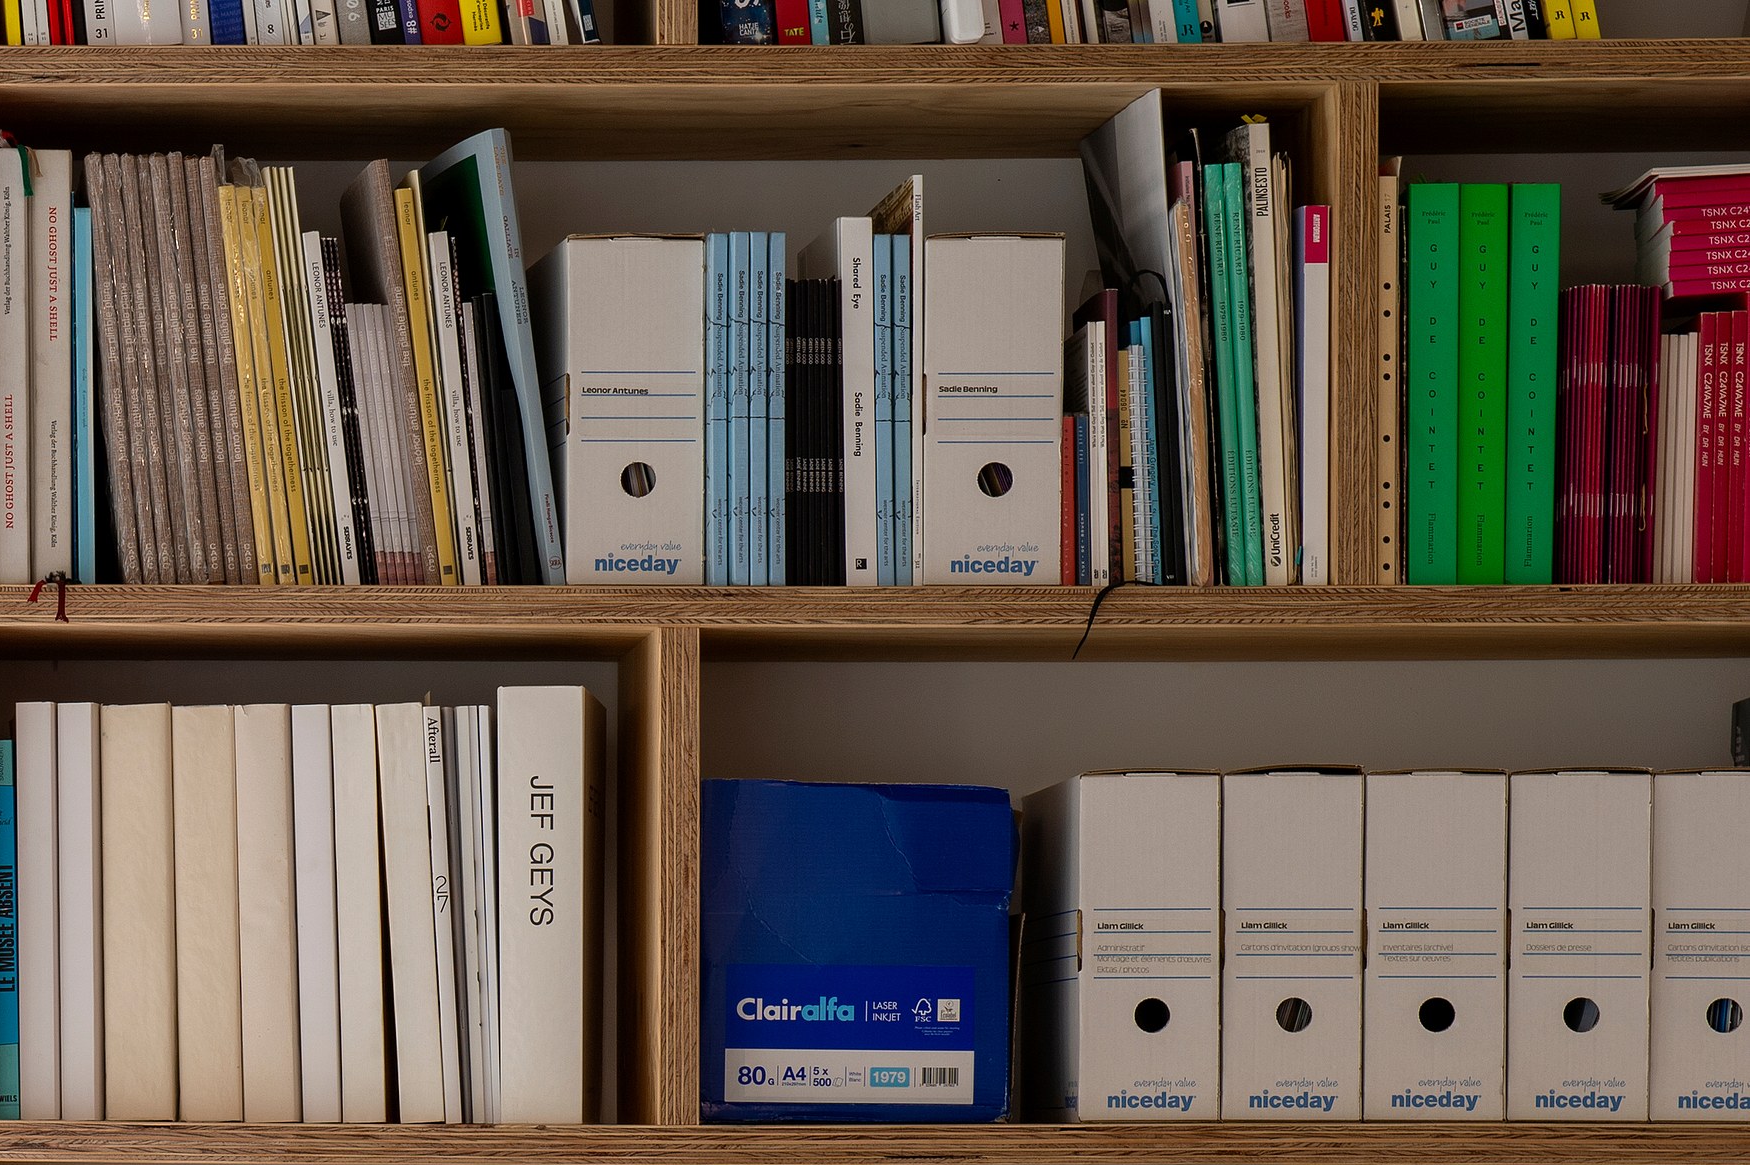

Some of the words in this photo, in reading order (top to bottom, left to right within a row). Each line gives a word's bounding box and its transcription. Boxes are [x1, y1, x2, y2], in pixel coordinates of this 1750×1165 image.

[96, 28, 108, 38] 31
[738, 22, 759, 30] HATJE
[784, 27, 804, 37] TATE
[1254, 167, 1269, 218] PALINSESTO
[49, 206, 57, 224] NO
[403, 201, 411, 226] leonor
[1701, 208, 1728, 217] TSNX
[1312, 214, 1321, 243] ARTFORUM
[48, 226, 58, 262] GHOST
[4, 244, 12, 286] Buchhandlung
[852, 257, 862, 289] Shared
[1430, 244, 1438, 289] GUY
[1479, 245, 1487, 290] GUY
[48, 265, 58, 292] JUST
[1711, 281, 1737, 290] TSNX
[49, 295, 58, 304] A
[218, 282, 228, 310] plane
[440, 262, 448, 298] LEONOR
[444, 300, 453, 329] ANTUNES
[853, 292, 862, 310] Eye
[49, 305, 58, 341] SHELL
[1238, 300, 1246, 341] 1979-1980
[1430, 317, 1436, 344] DE
[1478, 318, 1486, 345] DE
[1704, 344, 1713, 366] TSNX
[582, 386, 612, 394] Leonor
[938, 385, 962, 393] Sadie
[963, 385, 998, 394] Benning
[1703, 372, 1712, 419] C24VA7ME
[228, 390, 239, 428] antunes
[854, 392, 863, 417] Sadie
[854, 421, 863, 457] Benning
[1428, 371, 1436, 489] COINTET
[1477, 372, 1486, 490] COINTET
[1703, 424, 1710, 435] BY
[232, 431, 242, 463] leonor
[424, 393, 432, 420] frisson
[430, 445, 441, 493] togetherness
[1270, 513, 1280, 556] UniCredit
[1428, 513, 1436, 565] Flammarion
[620, 541, 658, 556] everyday
[660, 540, 682, 551] value
[594, 553, 680, 575] niceday
[950, 554, 1036, 576] niceday
[427, 717, 441, 764] Afterall
[530, 776, 554, 830] JEF
[435, 875, 448, 913] 27
[530, 842, 554, 926] GEYS
[1097, 922, 1118, 930] Liam
[1119, 922, 1144, 930] Gillick
[1549, 922, 1574, 930] Gillick
[1566, 945, 1592, 953] presse
[736, 996, 855, 1022] Clairalfa
[872, 1012, 901, 1022] INKJET
[873, 1002, 898, 1010] LASER
[737, 1066, 766, 1086] 80
[768, 1078, 775, 1086] G
[782, 1066, 807, 1082] A4
[813, 1067, 820, 1076] 5
[813, 1078, 832, 1087] 500
[872, 1071, 906, 1084] 1979
[1107, 1090, 1194, 1112] niceday
[1391, 1089, 1478, 1112] niceday
[1535, 1089, 1622, 1112] niceday
